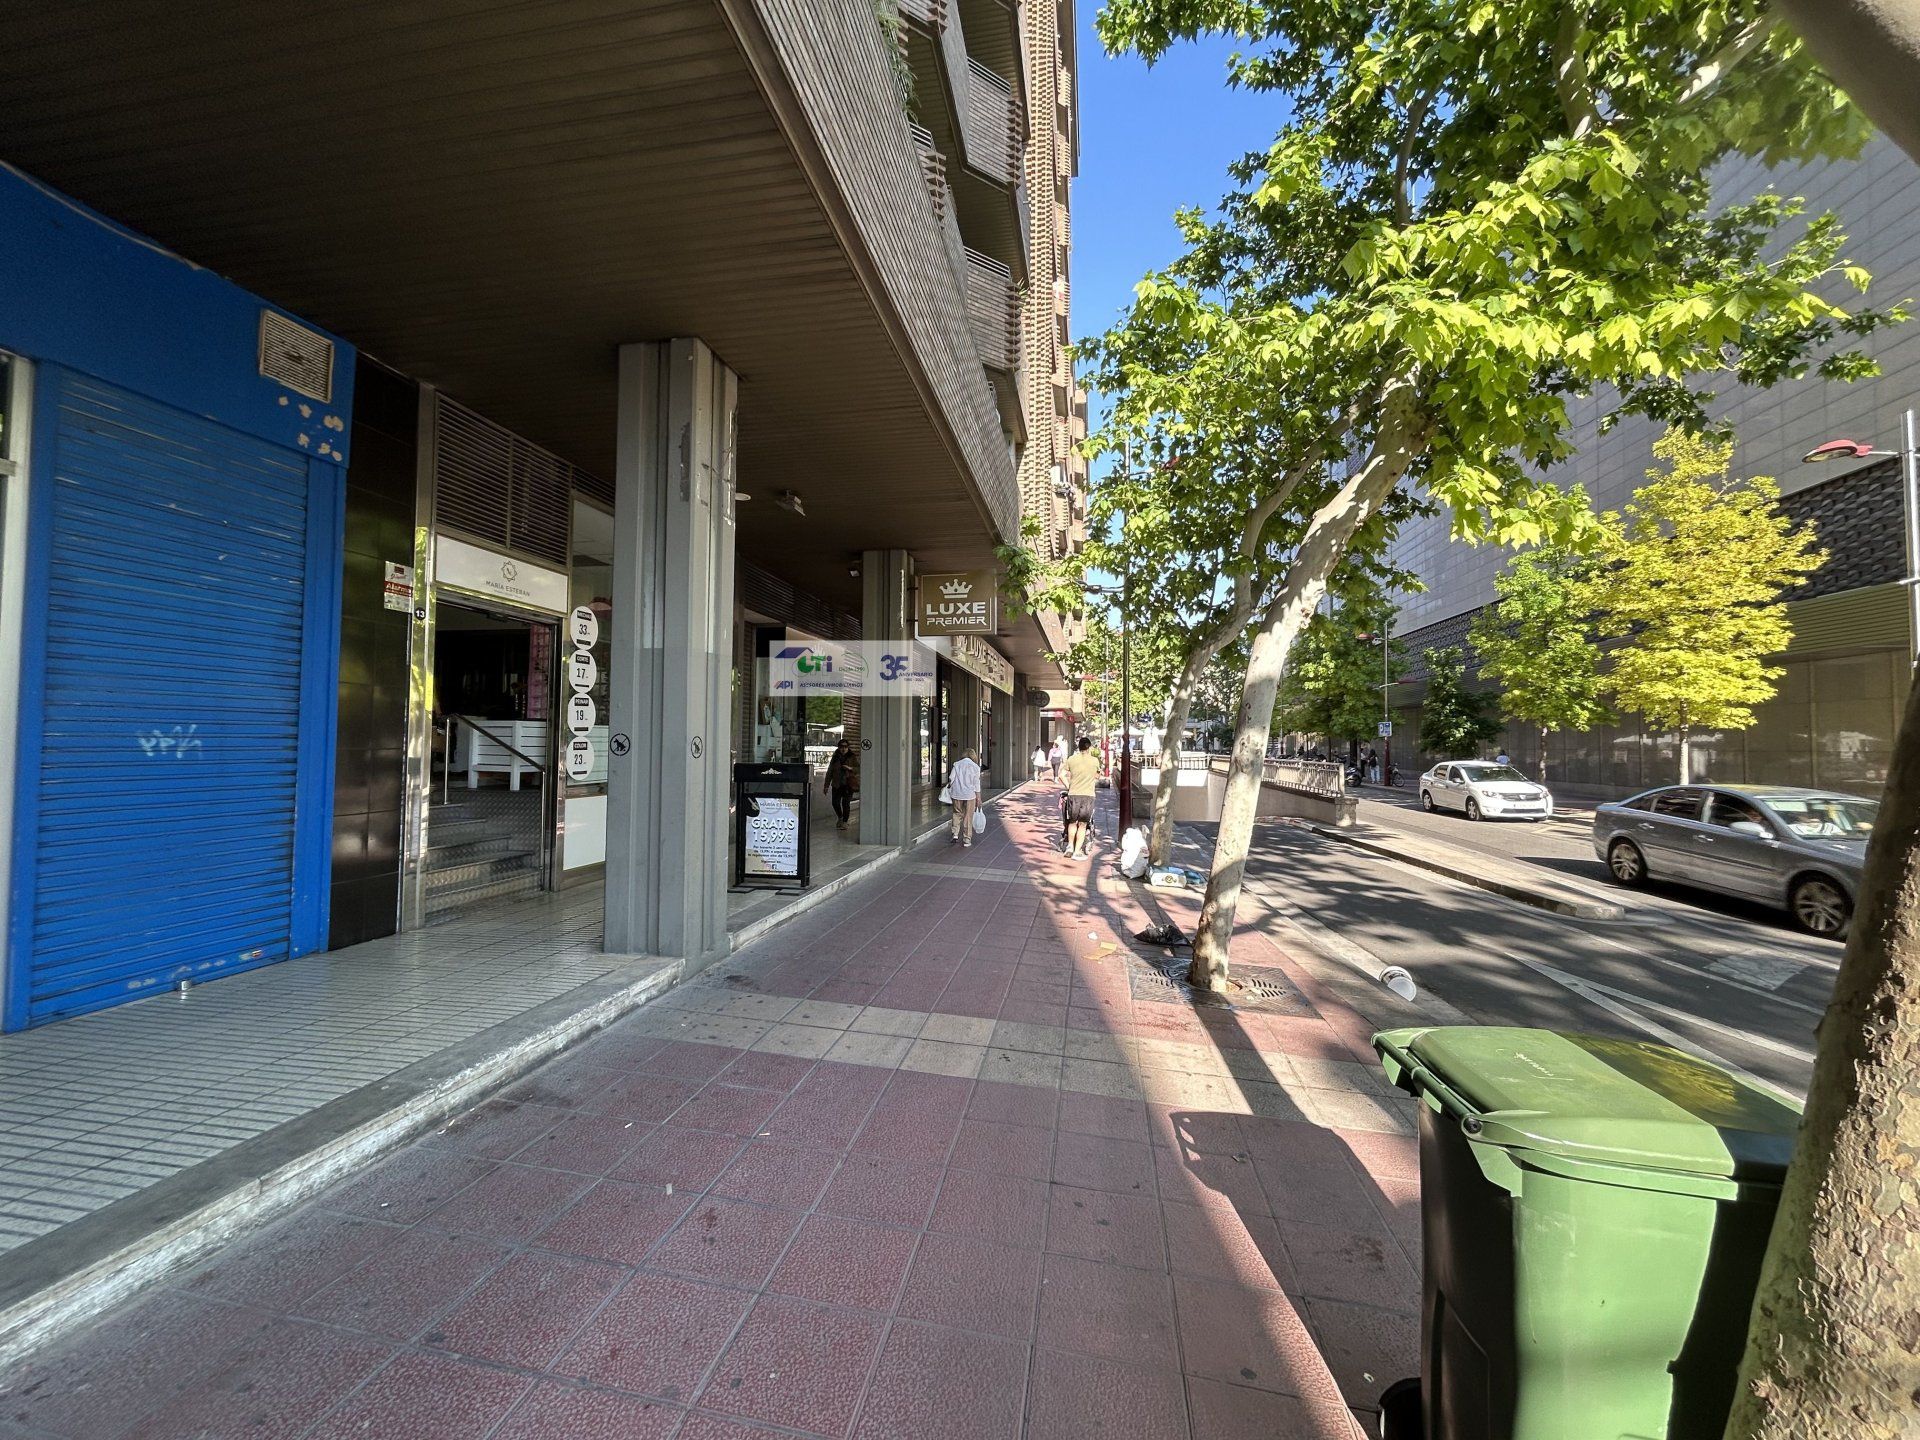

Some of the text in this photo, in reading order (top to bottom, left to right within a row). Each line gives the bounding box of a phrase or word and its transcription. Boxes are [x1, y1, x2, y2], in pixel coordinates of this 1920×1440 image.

[505, 585, 530, 597] ESTEBAN
[926, 601, 986, 615] LUXE
[415, 610, 425, 618] 13
[926, 616, 987, 627] PREMIER
[578, 624, 588, 635] 33
[576, 668, 586, 679] 17
[575, 710, 584, 720] 19
[574, 754, 583, 765] 23
[751, 817, 795, 830] GRATIS
[753, 830, 792, 844] 15,99€
